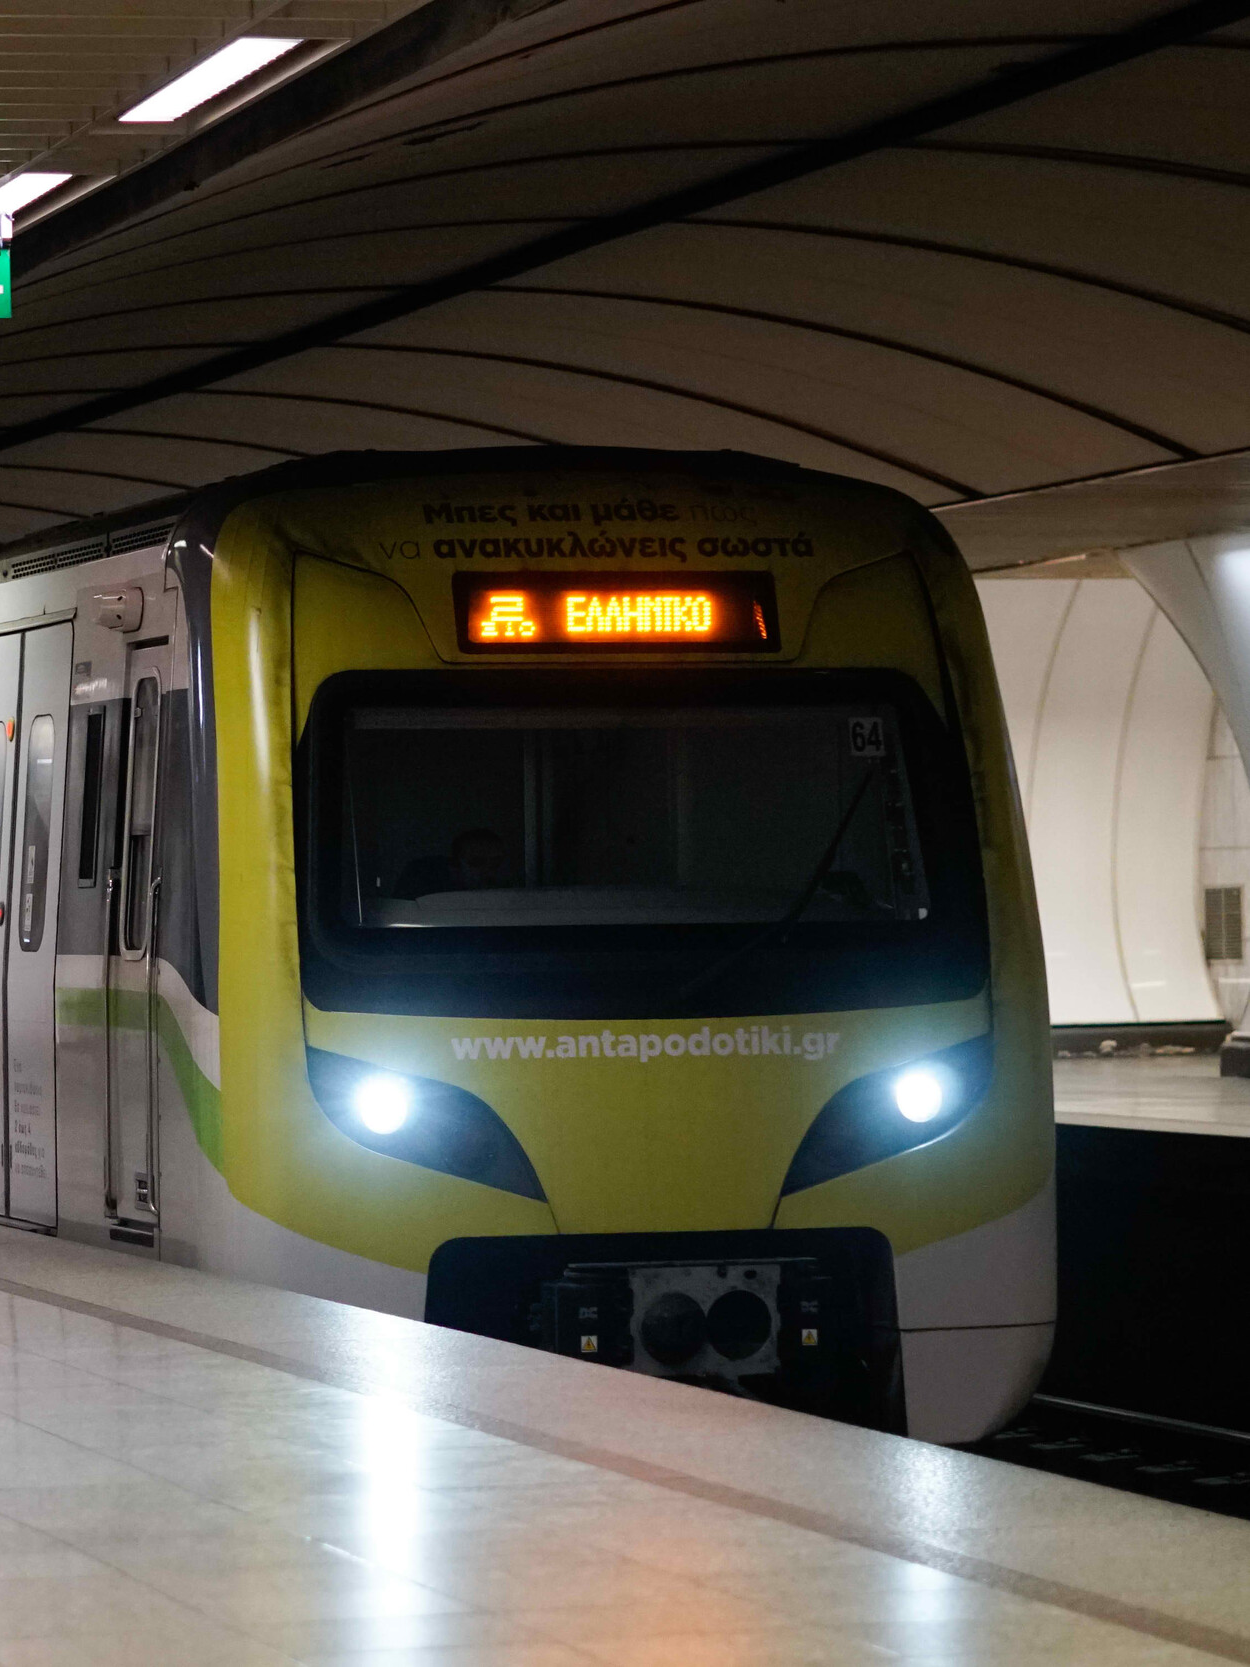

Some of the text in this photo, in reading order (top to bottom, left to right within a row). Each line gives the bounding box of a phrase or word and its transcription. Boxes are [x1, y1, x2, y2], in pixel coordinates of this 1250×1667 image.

[422, 502, 518, 527] Μπες
[527, 503, 581, 522] και
[590, 498, 680, 527] μάθε
[379, 531, 815, 563] να ανακυκλώνεις σωστά
[851, 720, 883, 753] 64
[451, 1026, 841, 1063] www.antapodotiki.gr
